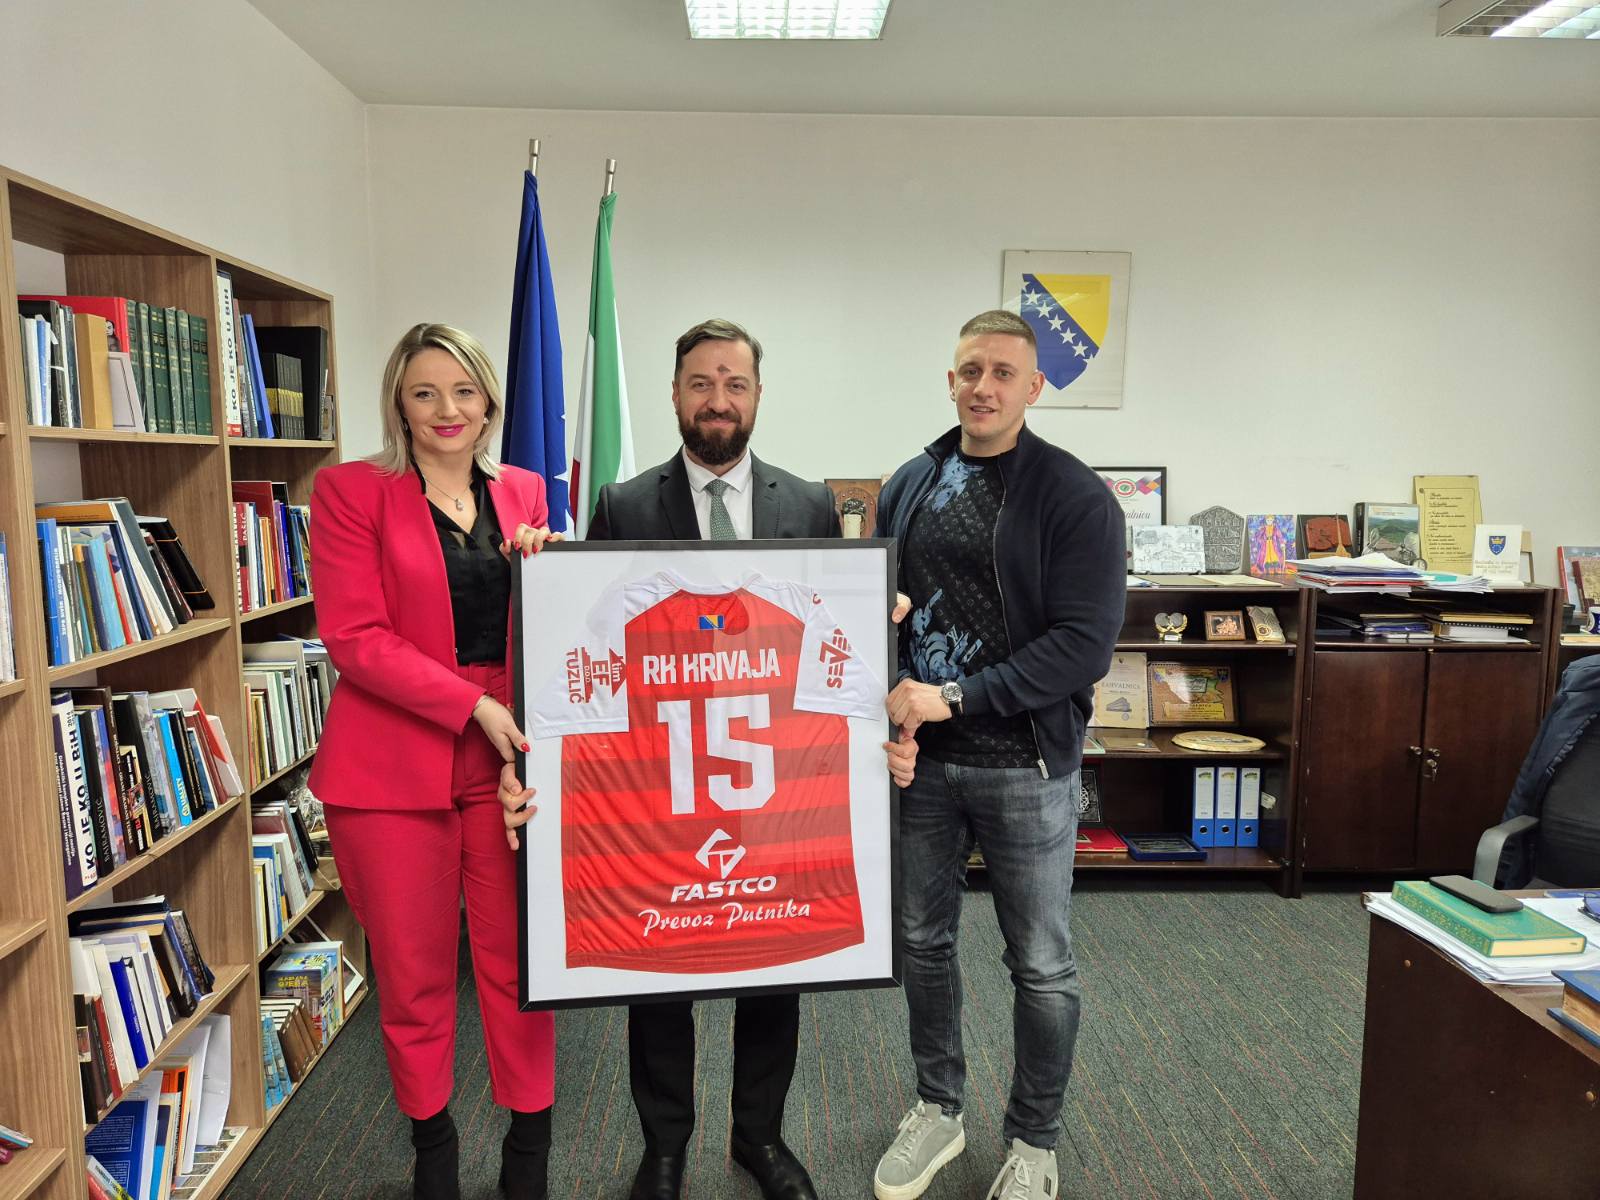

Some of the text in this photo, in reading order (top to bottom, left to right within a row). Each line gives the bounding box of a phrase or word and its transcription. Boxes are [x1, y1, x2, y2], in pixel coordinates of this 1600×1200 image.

[226, 321, 232, 332] U
[227, 338, 234, 360] KO
[229, 366, 236, 383] JE
[231, 388, 238, 410] KO
[239, 512, 247, 540] PAŠIĆ
[566, 648, 585, 703] TUZLIĆ
[591, 660, 610, 686] EF
[643, 648, 781, 685] RK KRIVAJA
[657, 694, 776, 815] 15
[78, 785, 89, 812] KO
[85, 843, 95, 870] KO
[670, 875, 777, 903] FASTCO
[638, 898, 811, 937] Prevoz Putnika
